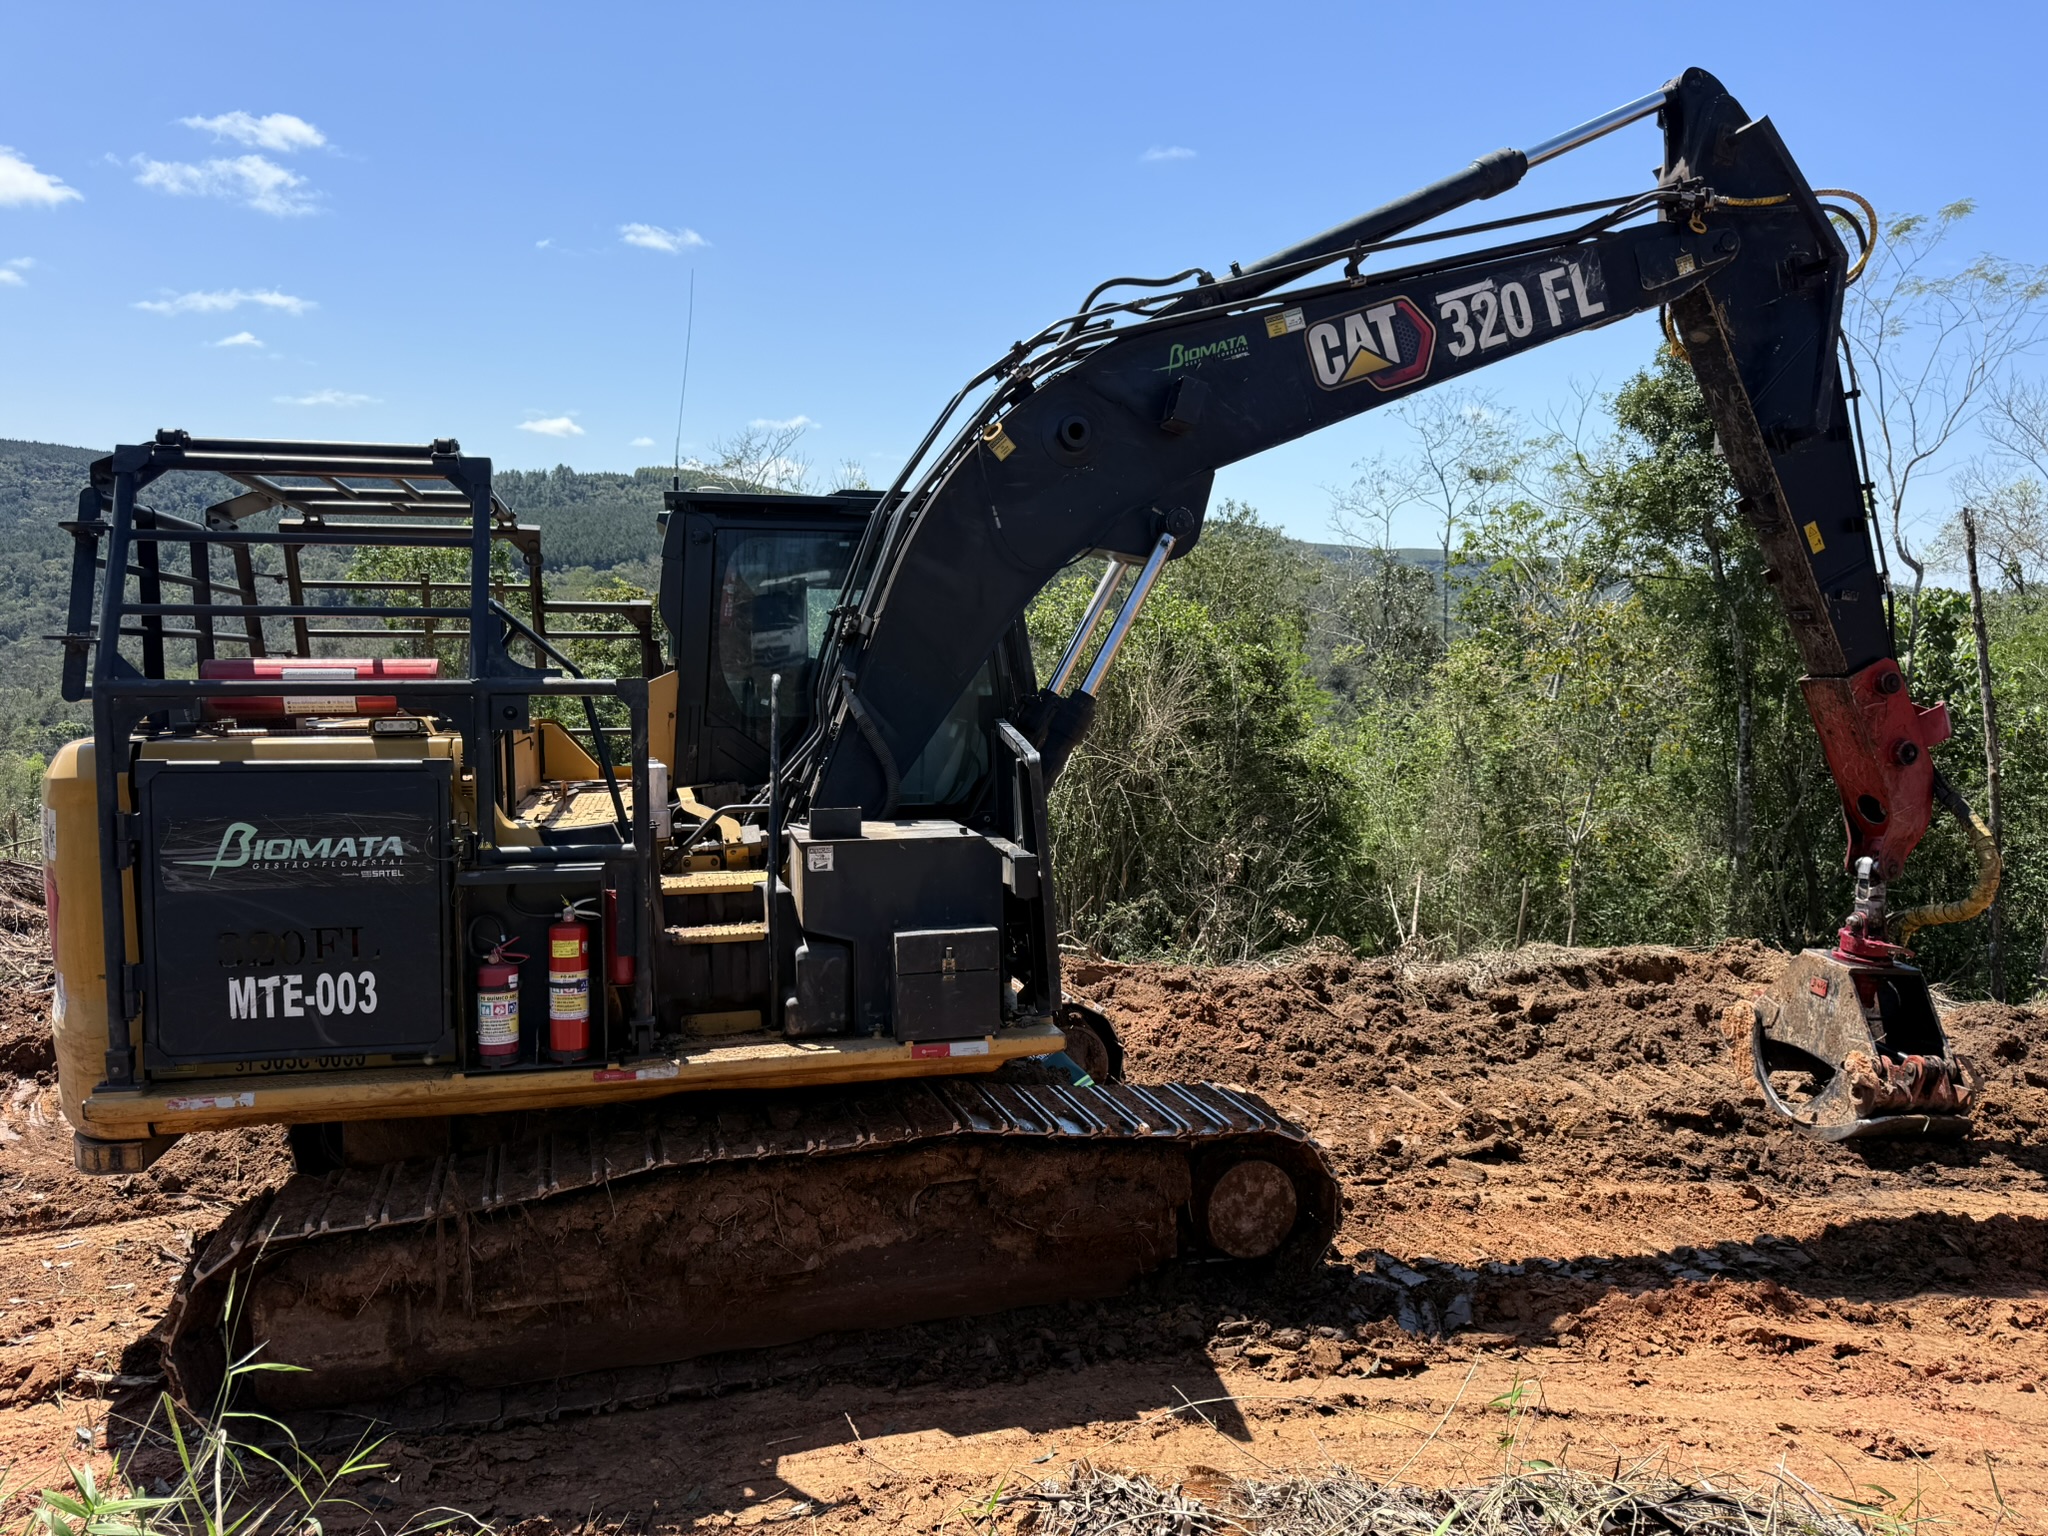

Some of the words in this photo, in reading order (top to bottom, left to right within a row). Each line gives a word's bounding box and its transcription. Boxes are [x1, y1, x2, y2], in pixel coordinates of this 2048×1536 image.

[1440, 280, 1533, 357] 320
[1539, 262, 1605, 328] FL
[1152, 335, 1248, 376] BIOMATA
[1308, 302, 1401, 385] CAT
[173, 822, 404, 880] BIOMATA
[228, 971, 378, 1020] MTE-003
